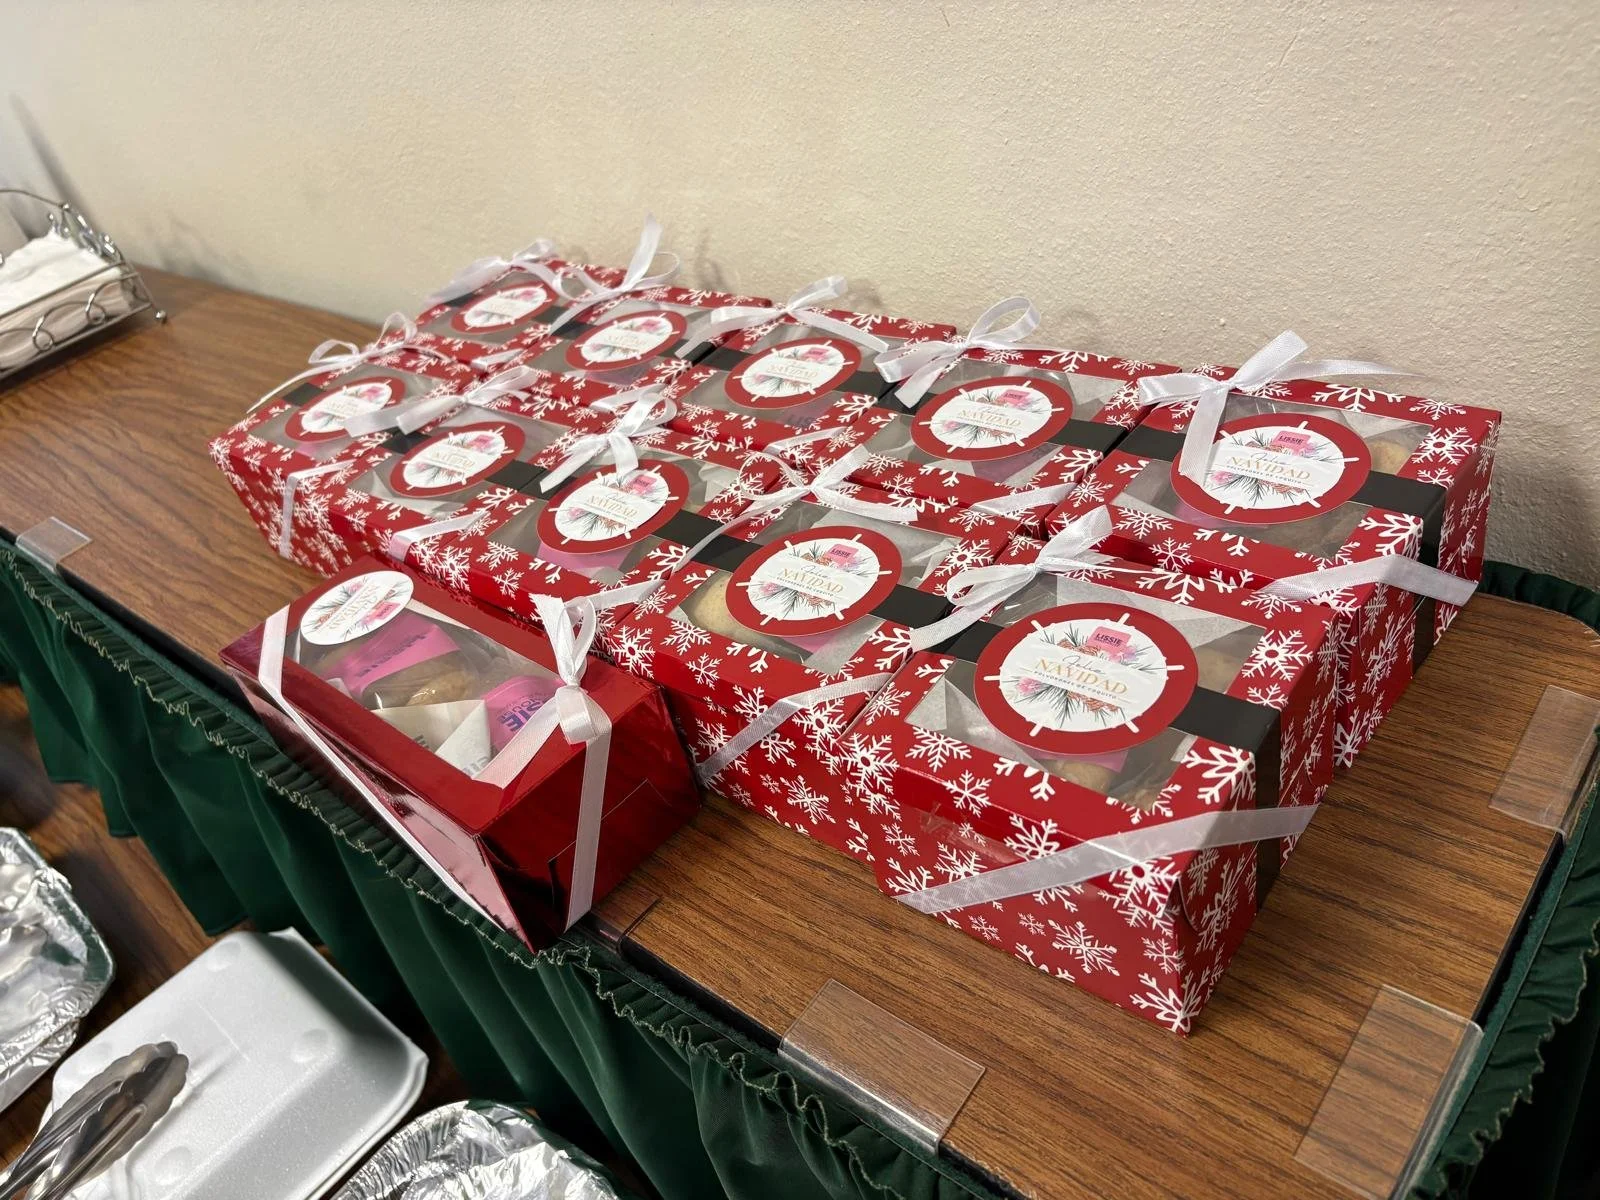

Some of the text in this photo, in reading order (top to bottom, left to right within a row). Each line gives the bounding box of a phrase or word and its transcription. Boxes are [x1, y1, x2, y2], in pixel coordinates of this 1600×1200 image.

[957, 409, 1022, 427] NAVIDAD
[1226, 456, 1311, 480] NAVIDAD
[777, 568, 844, 593] NAVIDAD
[1094, 633, 1123, 645] LISSIE
[1035, 658, 1128, 694] NAVIDAD
